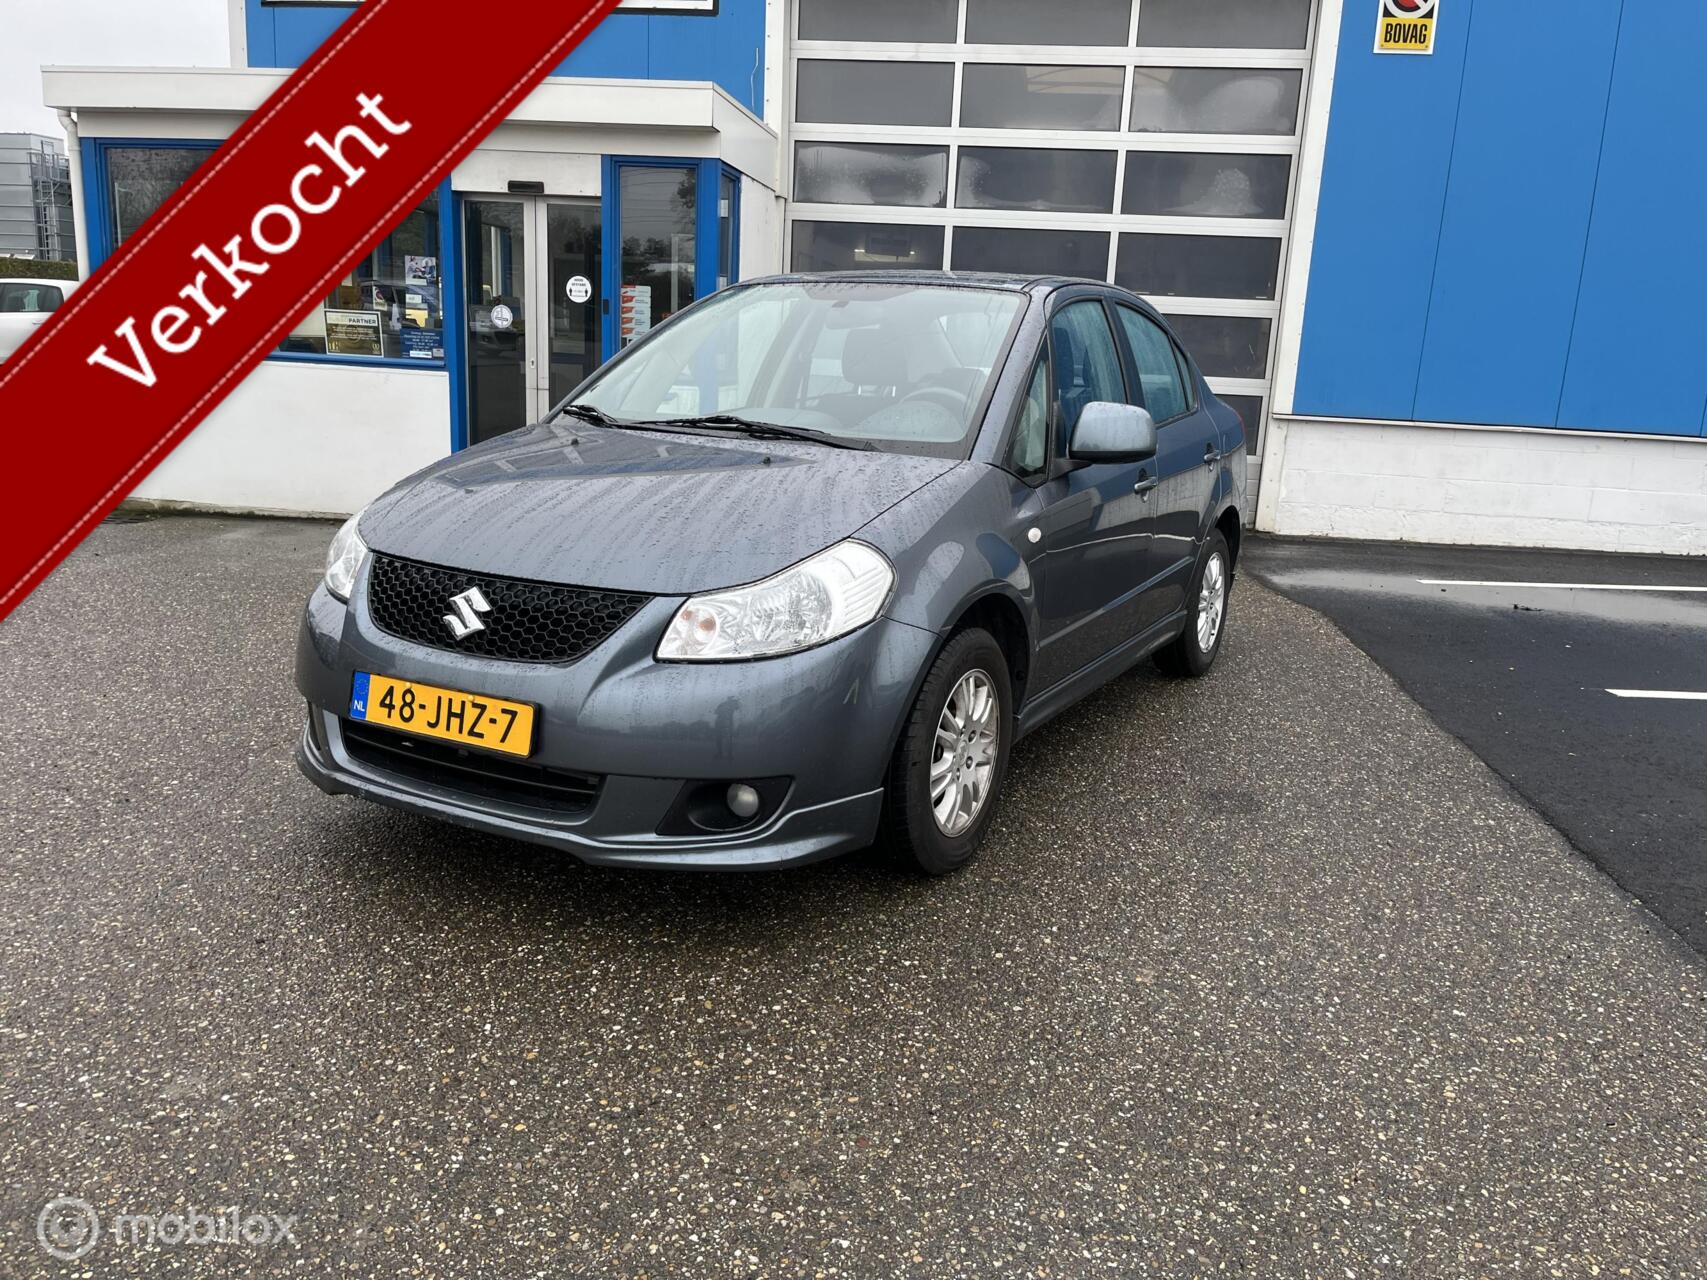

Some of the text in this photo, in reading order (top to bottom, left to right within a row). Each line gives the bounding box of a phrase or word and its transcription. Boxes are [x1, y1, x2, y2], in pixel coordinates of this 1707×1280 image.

[1384, 23, 1428, 44] BOVAG
[348, 317, 376, 325] PARTNER
[353, 699, 366, 712] NL
[379, 685, 518, 743] 48-JHZ-7
